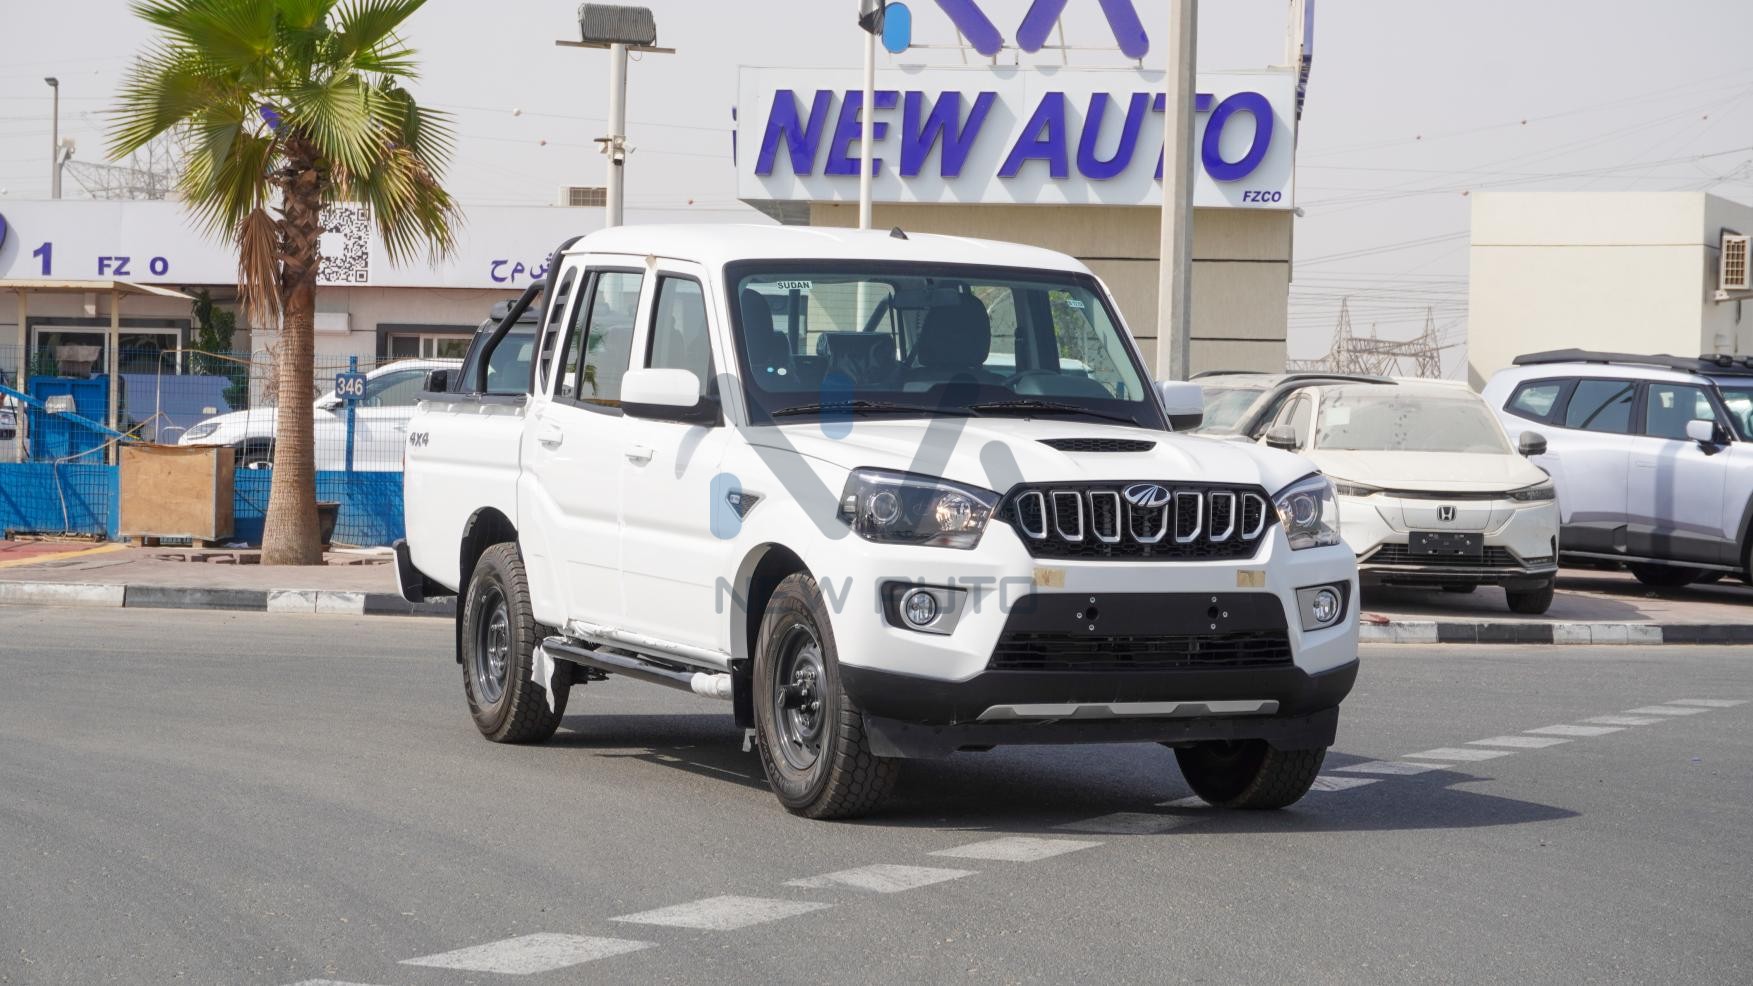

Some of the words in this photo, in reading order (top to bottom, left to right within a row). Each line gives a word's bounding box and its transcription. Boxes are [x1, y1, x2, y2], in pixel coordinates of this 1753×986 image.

[755, 88, 998, 178] NEW
[1242, 190, 1282, 203] FZCO
[33, 242, 53, 276] 1
[777, 280, 810, 290] SUDAN
[336, 377, 364, 396] 346
